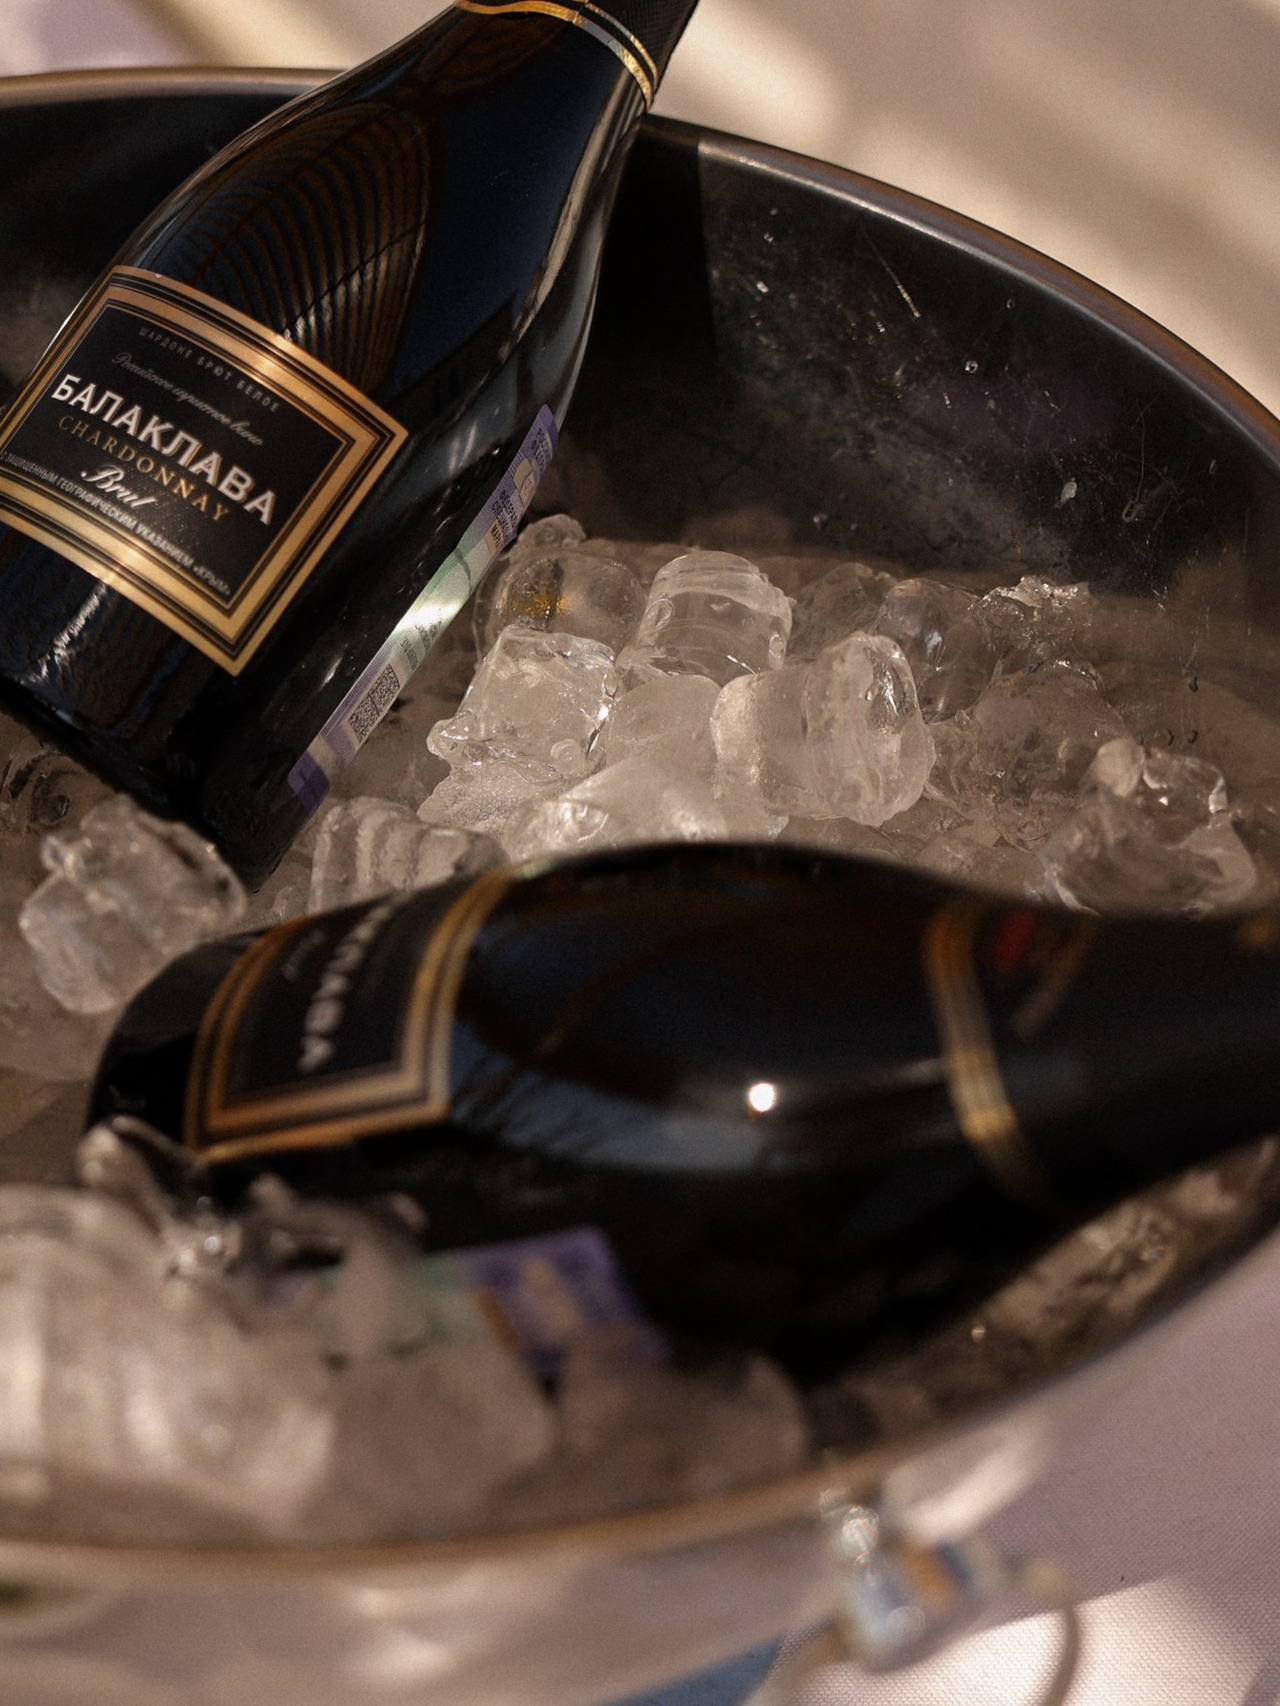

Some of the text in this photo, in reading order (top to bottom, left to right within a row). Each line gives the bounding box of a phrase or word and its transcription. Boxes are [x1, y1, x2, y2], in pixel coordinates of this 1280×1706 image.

[138, 327, 281, 414] ШАРДОНЕ БРЮТ БЕЛОЕ
[51, 374, 277, 526] БАЛАКЛАВА
[59, 415, 230, 522] CHARDONNAY
[81, 464, 158, 508] Brut
[4, 453, 59, 485] ЗАЩИЩЕННЫМ
[56, 477, 138, 530] ГЕОГРАФИЧЕСКИМ
[135, 522, 195, 568] УКАЗАНИЕМ
